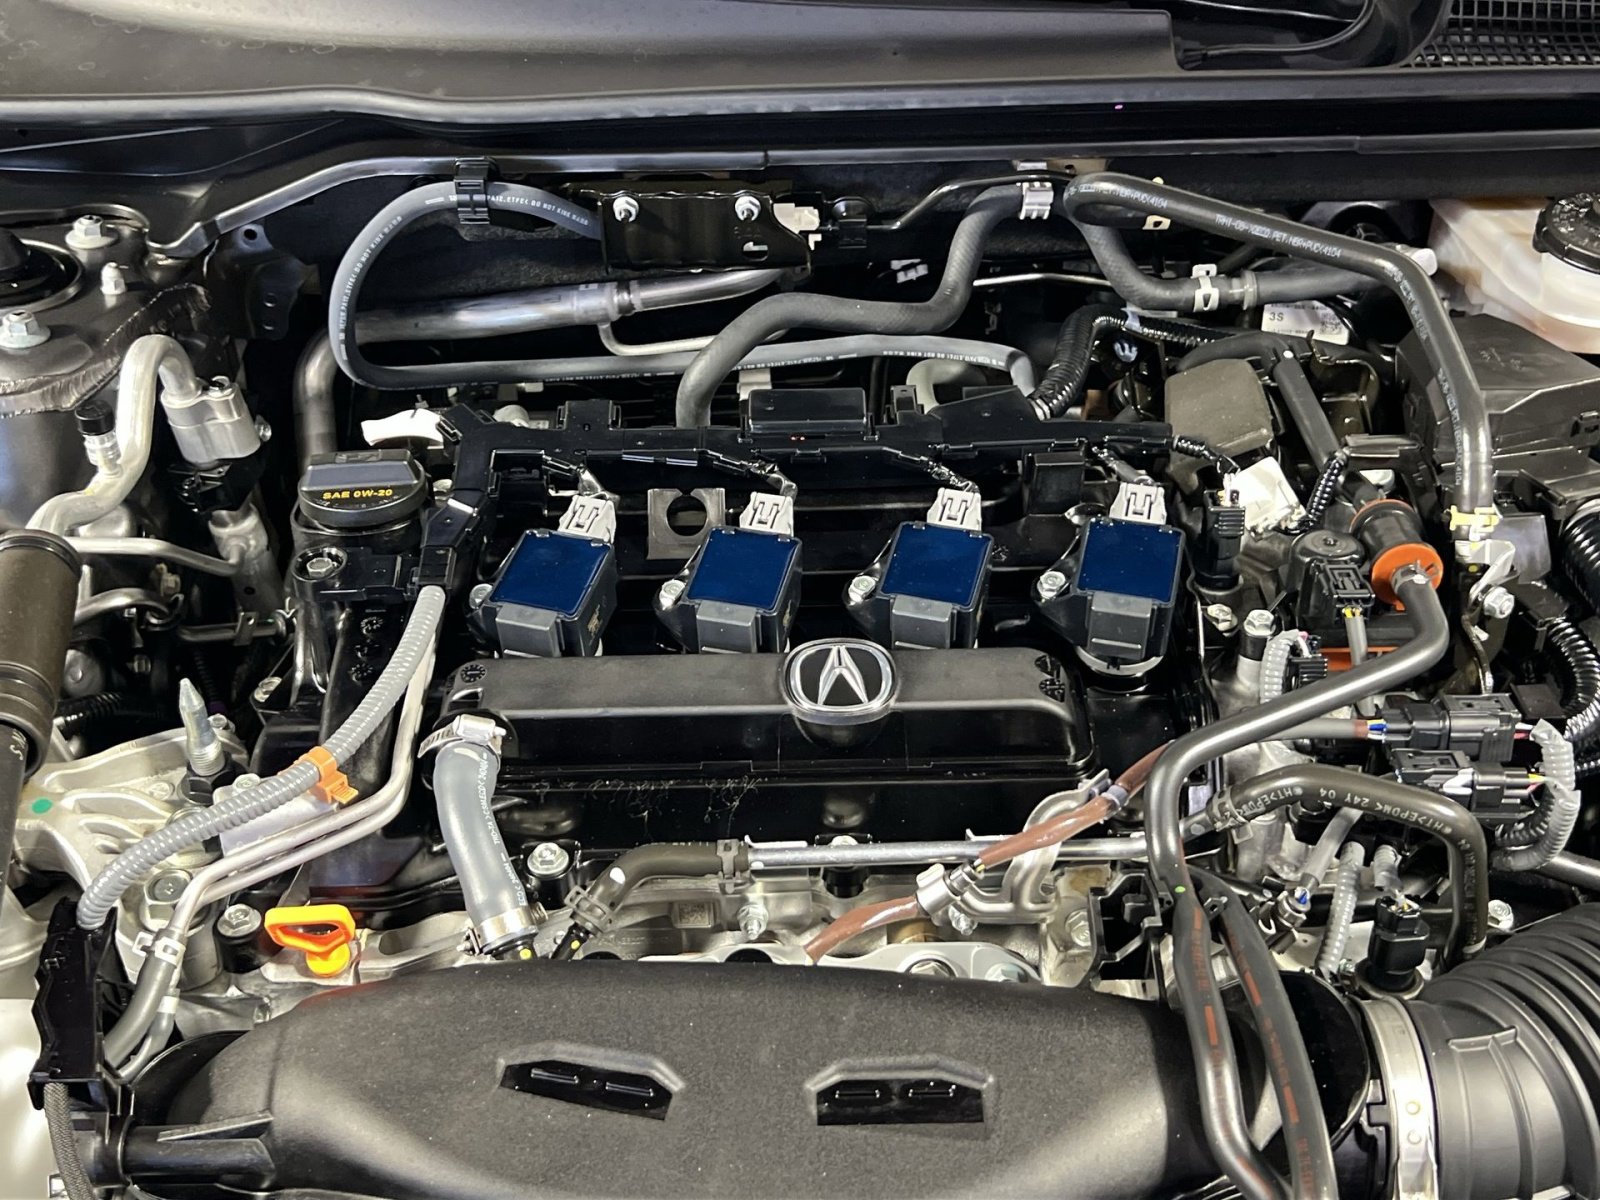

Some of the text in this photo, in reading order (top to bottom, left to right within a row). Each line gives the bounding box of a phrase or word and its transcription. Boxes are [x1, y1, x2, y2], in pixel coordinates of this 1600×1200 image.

[1269, 312, 1284, 322] 3S
[322, 488, 394, 500] SAE 0W-20
[1318, 787, 1336, 799] 04
[1343, 796, 1370, 808] 24Y
